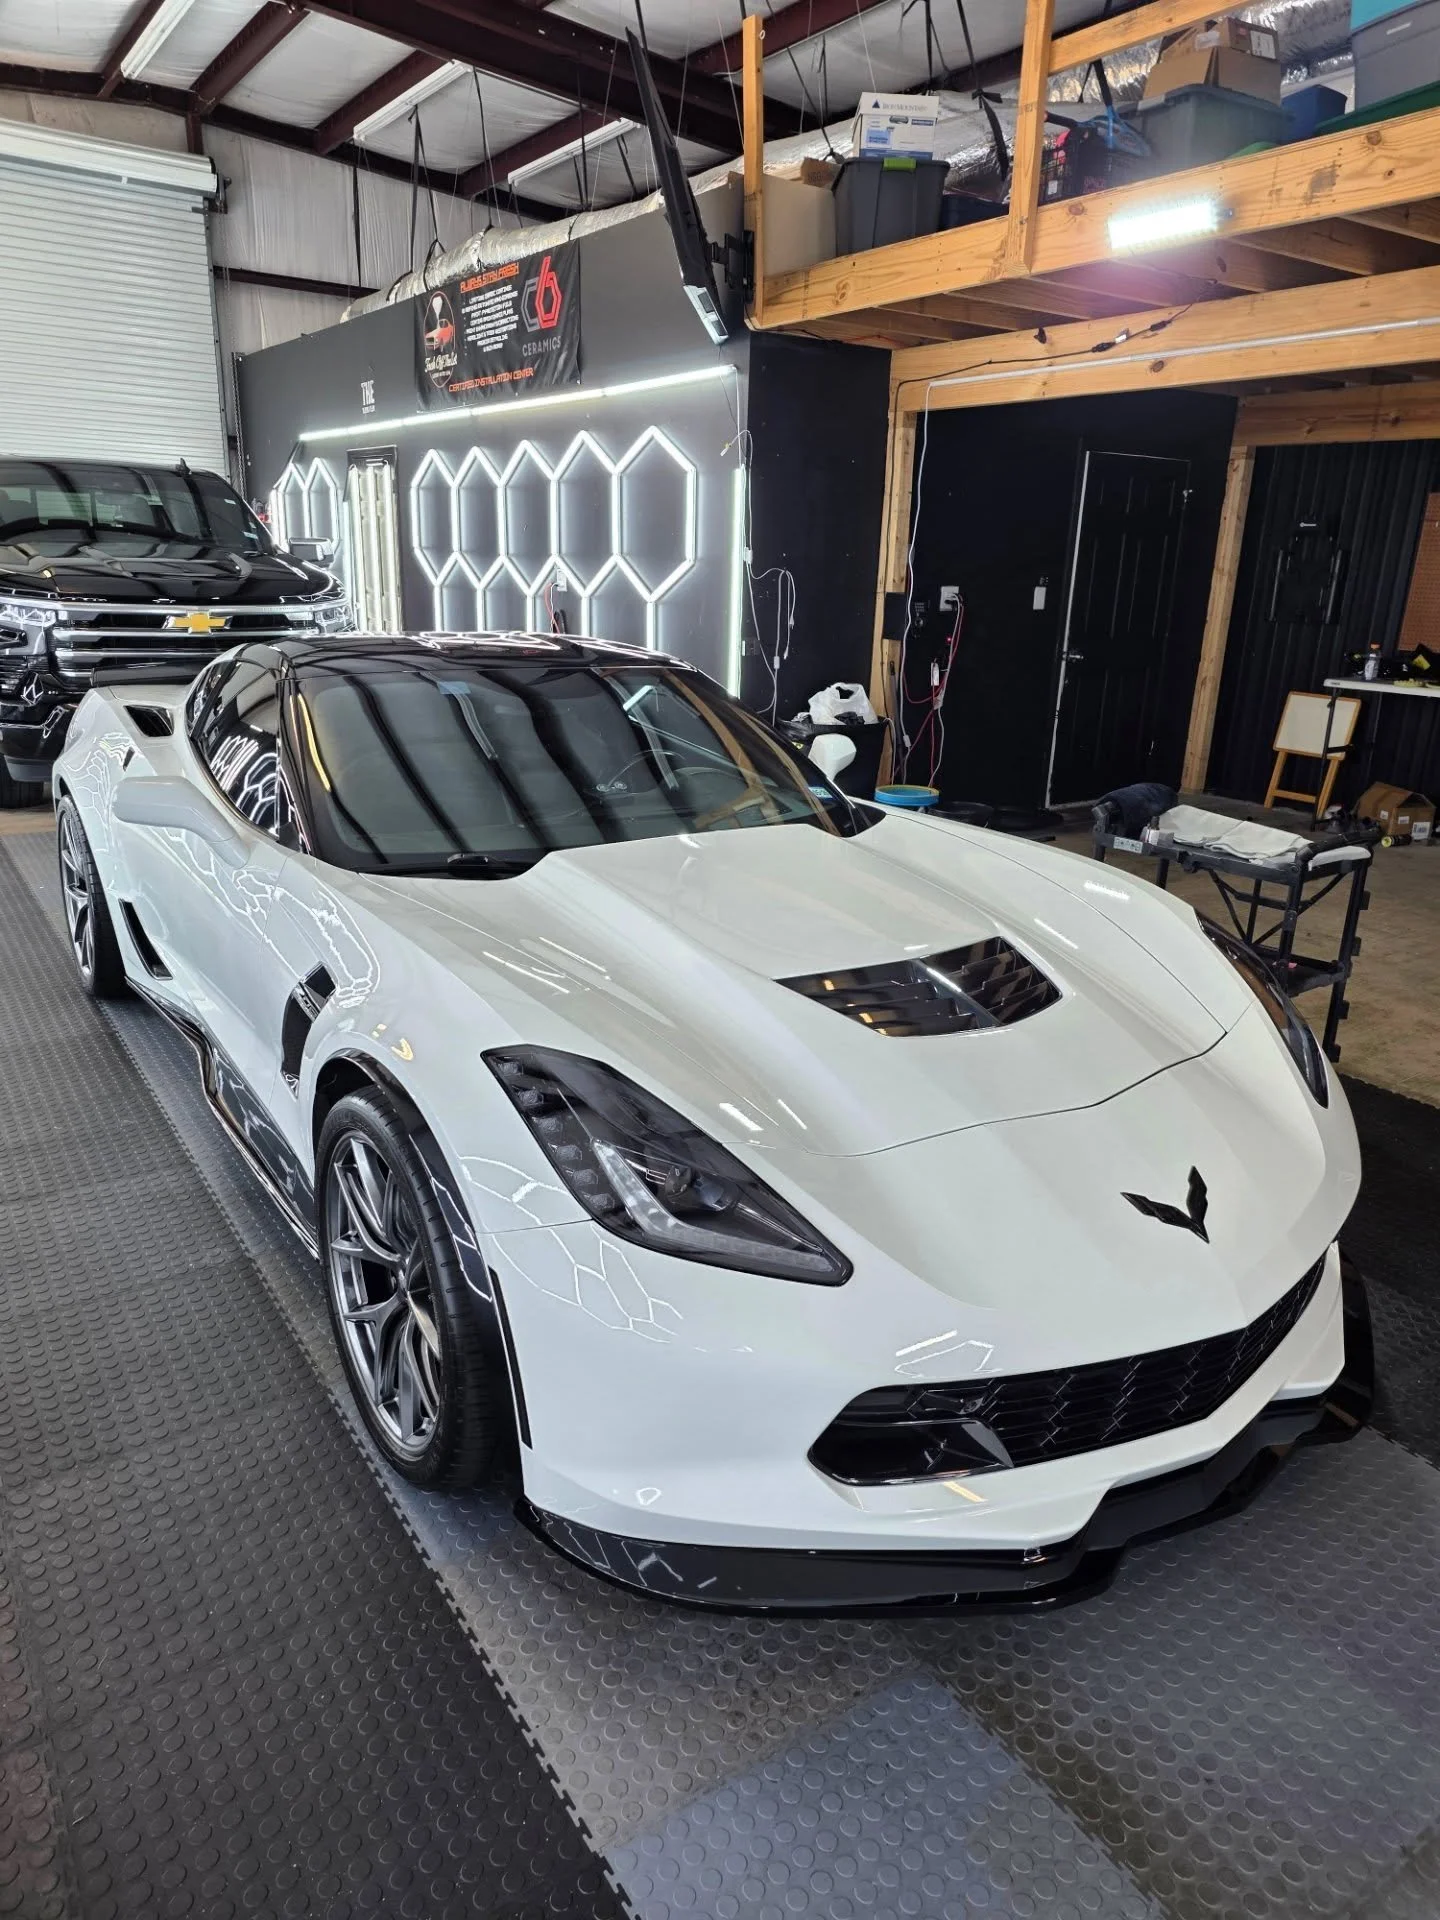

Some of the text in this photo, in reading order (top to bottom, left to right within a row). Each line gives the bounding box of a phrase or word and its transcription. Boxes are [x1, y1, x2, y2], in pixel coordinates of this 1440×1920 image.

[522, 336, 561, 357] CERAMICS
[474, 371, 513, 388] INSTALLATION
[513, 367, 534, 380] CENTER
